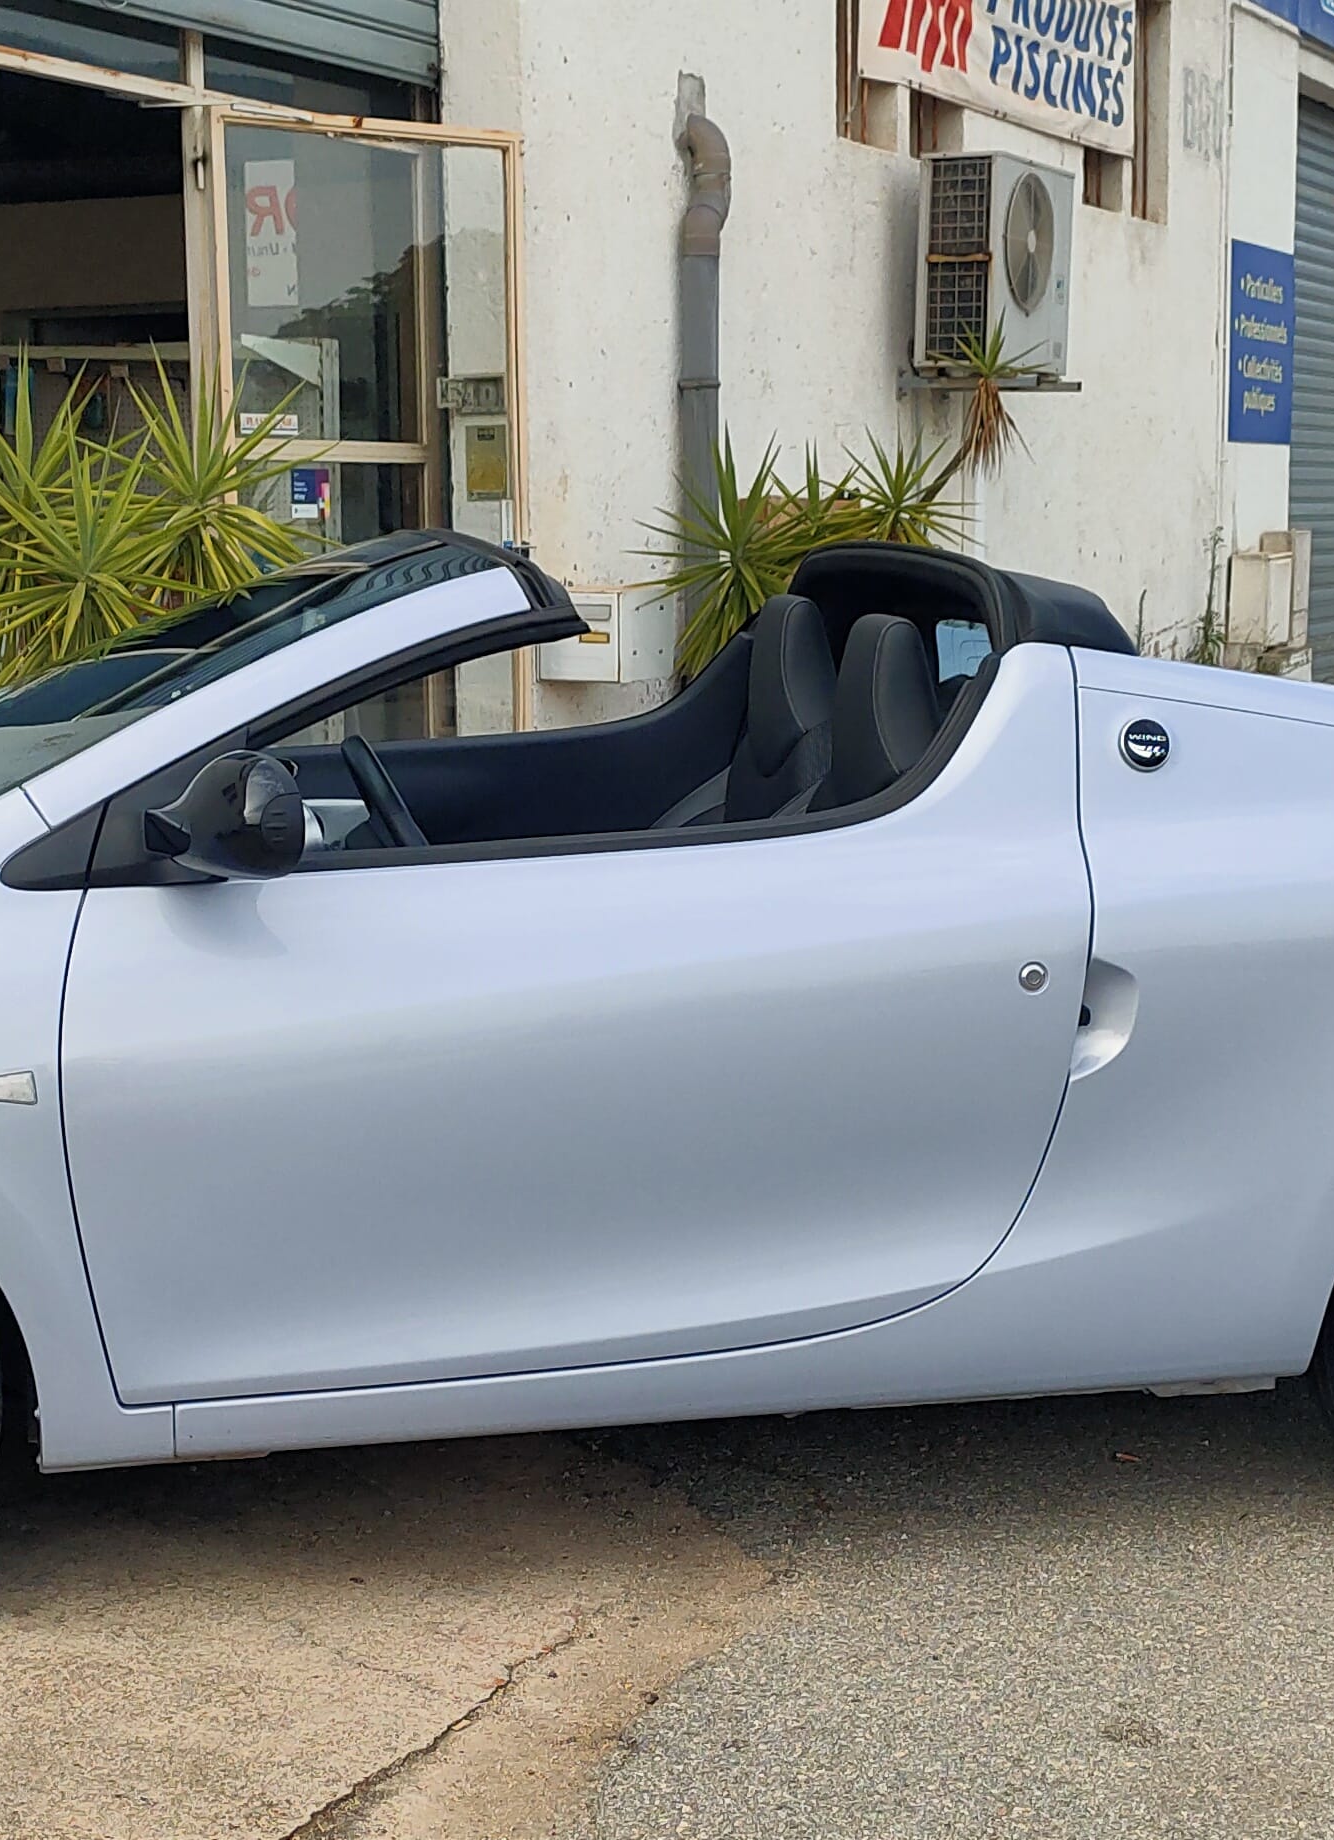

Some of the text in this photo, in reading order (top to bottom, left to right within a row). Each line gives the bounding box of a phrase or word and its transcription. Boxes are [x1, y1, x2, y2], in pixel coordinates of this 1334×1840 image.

[987, 0, 1133, 66] RODUITS
[989, 25, 1125, 127] PISCINES
[1246, 273, 1283, 304] Particuliers
[1240, 313, 1288, 344] Professionnels
[1243, 353, 1283, 383] Collectivités
[1242, 385, 1276, 417] publiques
[1129, 733, 1167, 742] WIND
